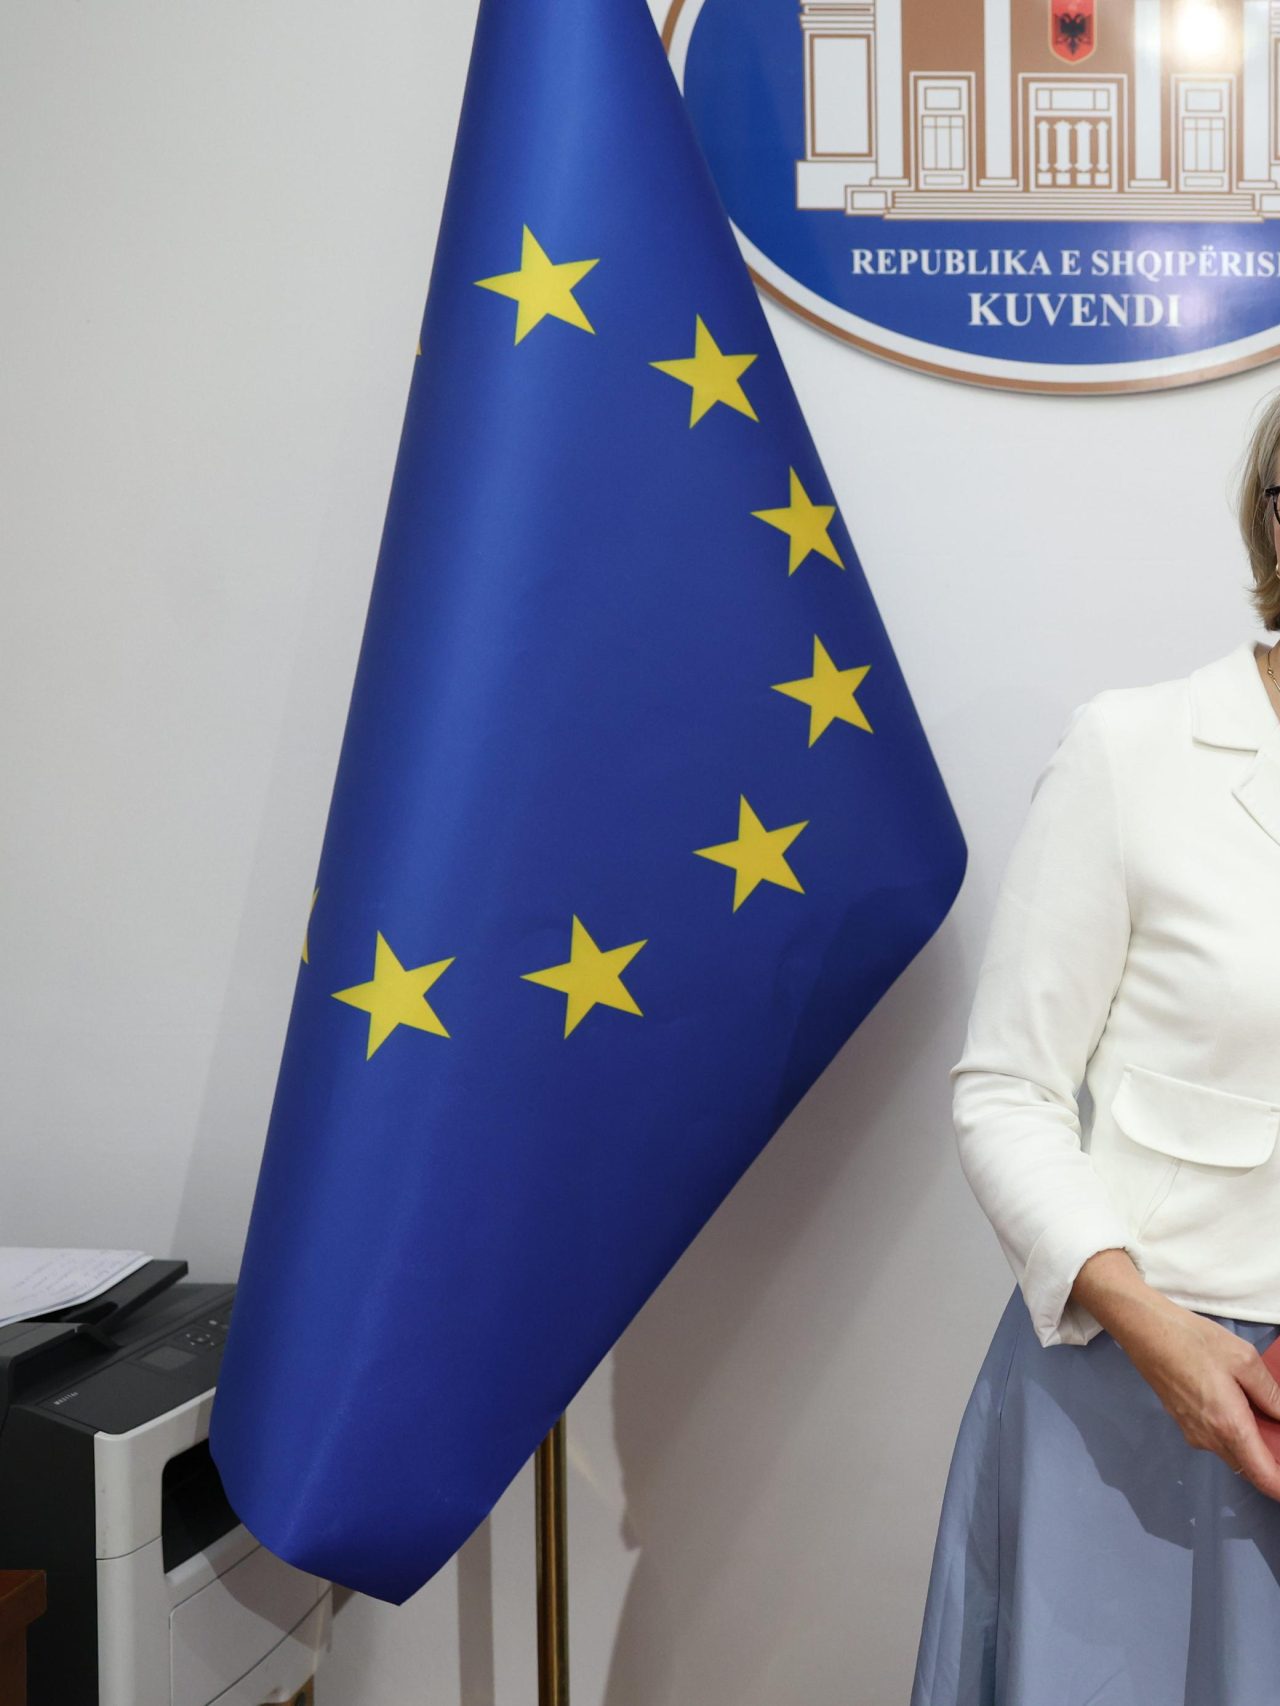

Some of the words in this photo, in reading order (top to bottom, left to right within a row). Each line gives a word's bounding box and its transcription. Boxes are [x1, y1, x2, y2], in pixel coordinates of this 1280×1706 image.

[851, 248, 1051, 275] REPUBLIKA
[1061, 249, 1082, 275] E
[967, 292, 1183, 328] KUVENDI
